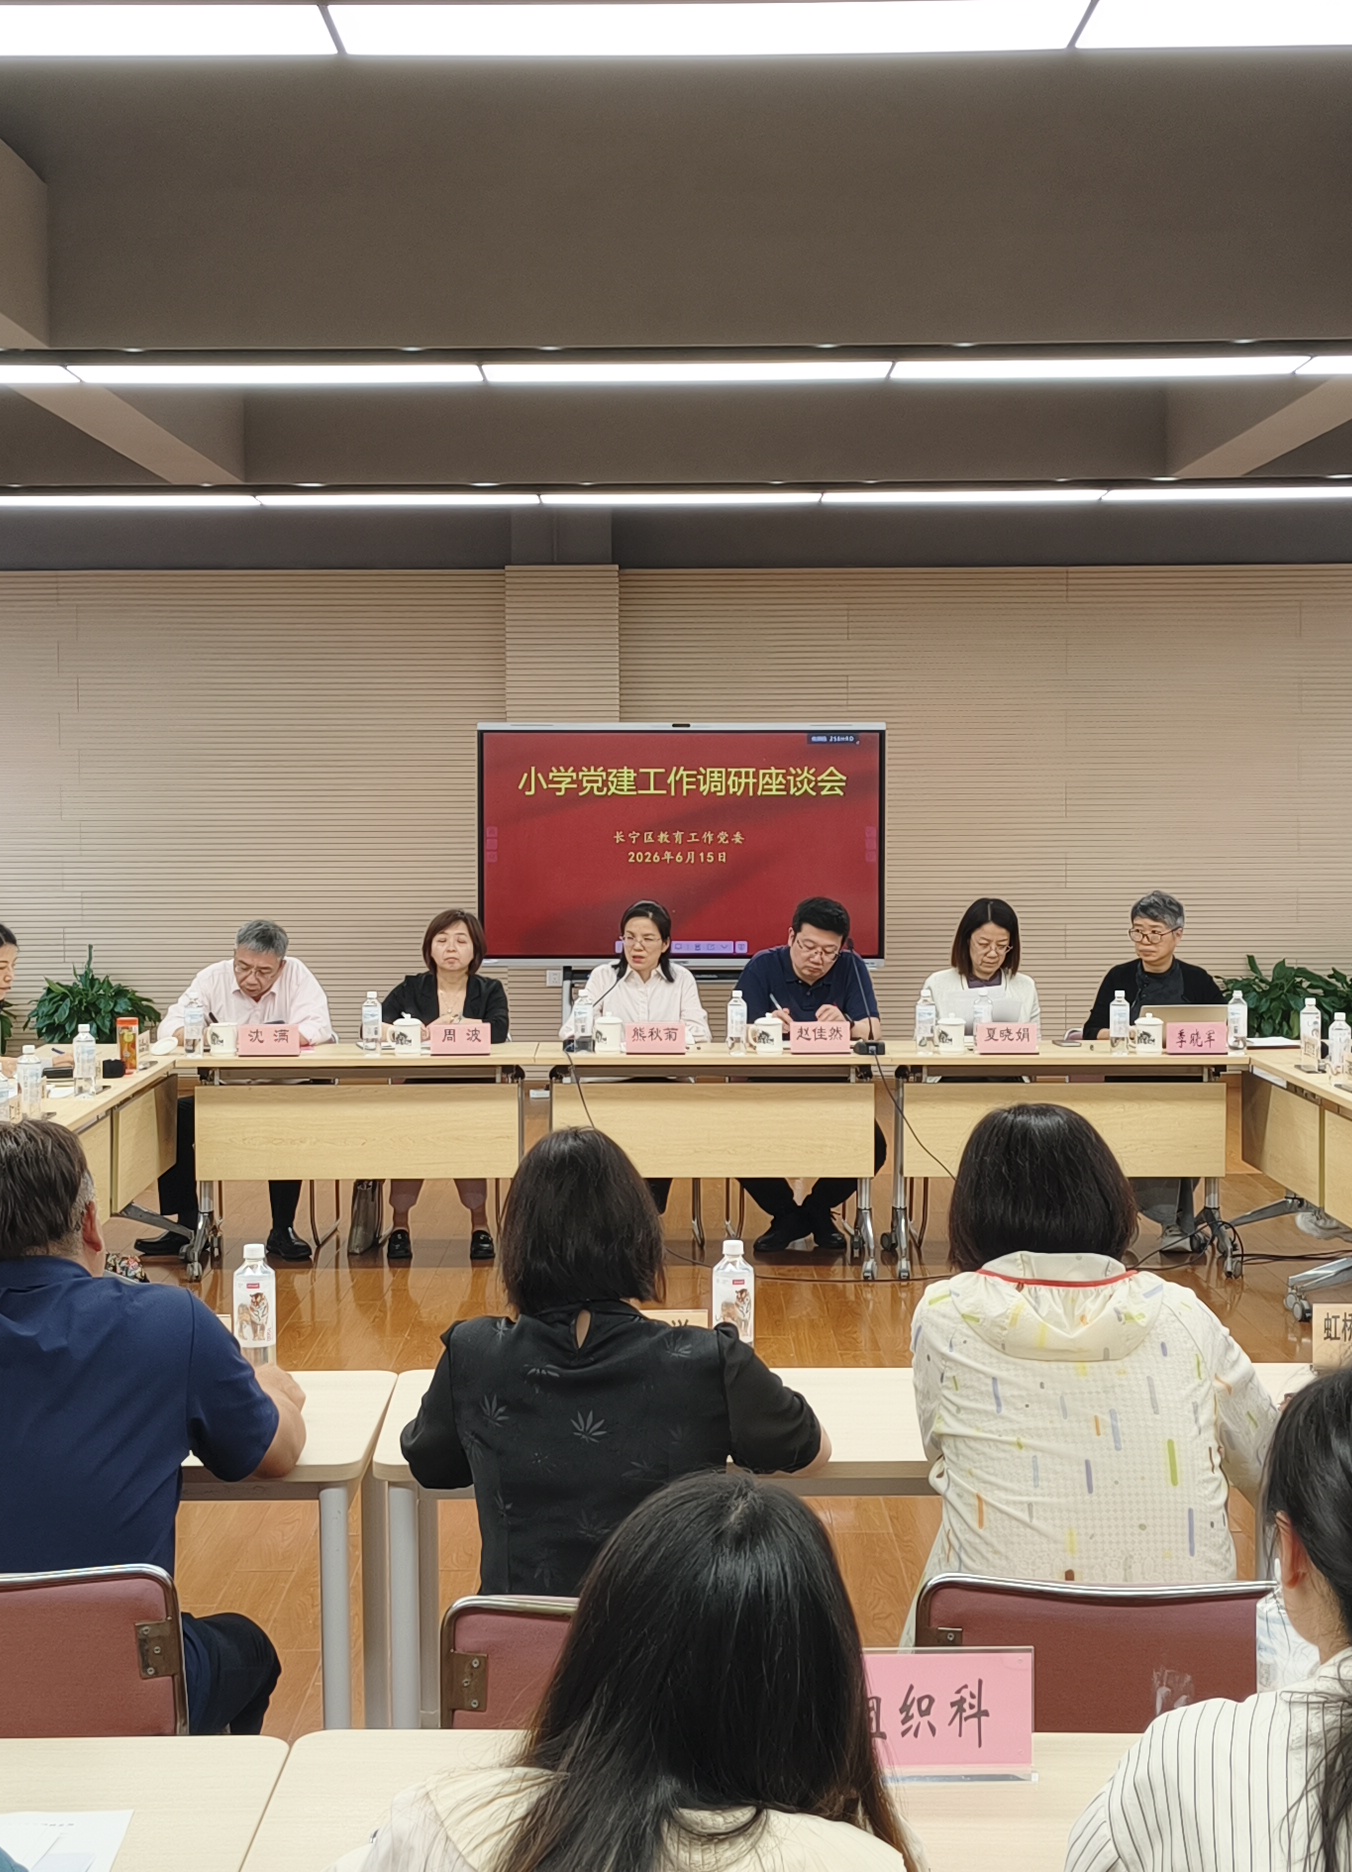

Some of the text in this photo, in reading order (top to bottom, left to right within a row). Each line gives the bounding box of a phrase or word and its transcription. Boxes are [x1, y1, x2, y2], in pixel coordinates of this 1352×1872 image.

[518, 765, 846, 797] 小学党建工作调研座谈会
[613, 831, 745, 845] 长宁区教育工作党委
[628, 850, 727, 864] 2026年6月15日
[442, 1028, 482, 1043] 周波
[632, 1026, 679, 1042] 熊秋菊
[796, 1026, 843, 1041] 赵佳然
[984, 1026, 1030, 1042] 夏晓娟
